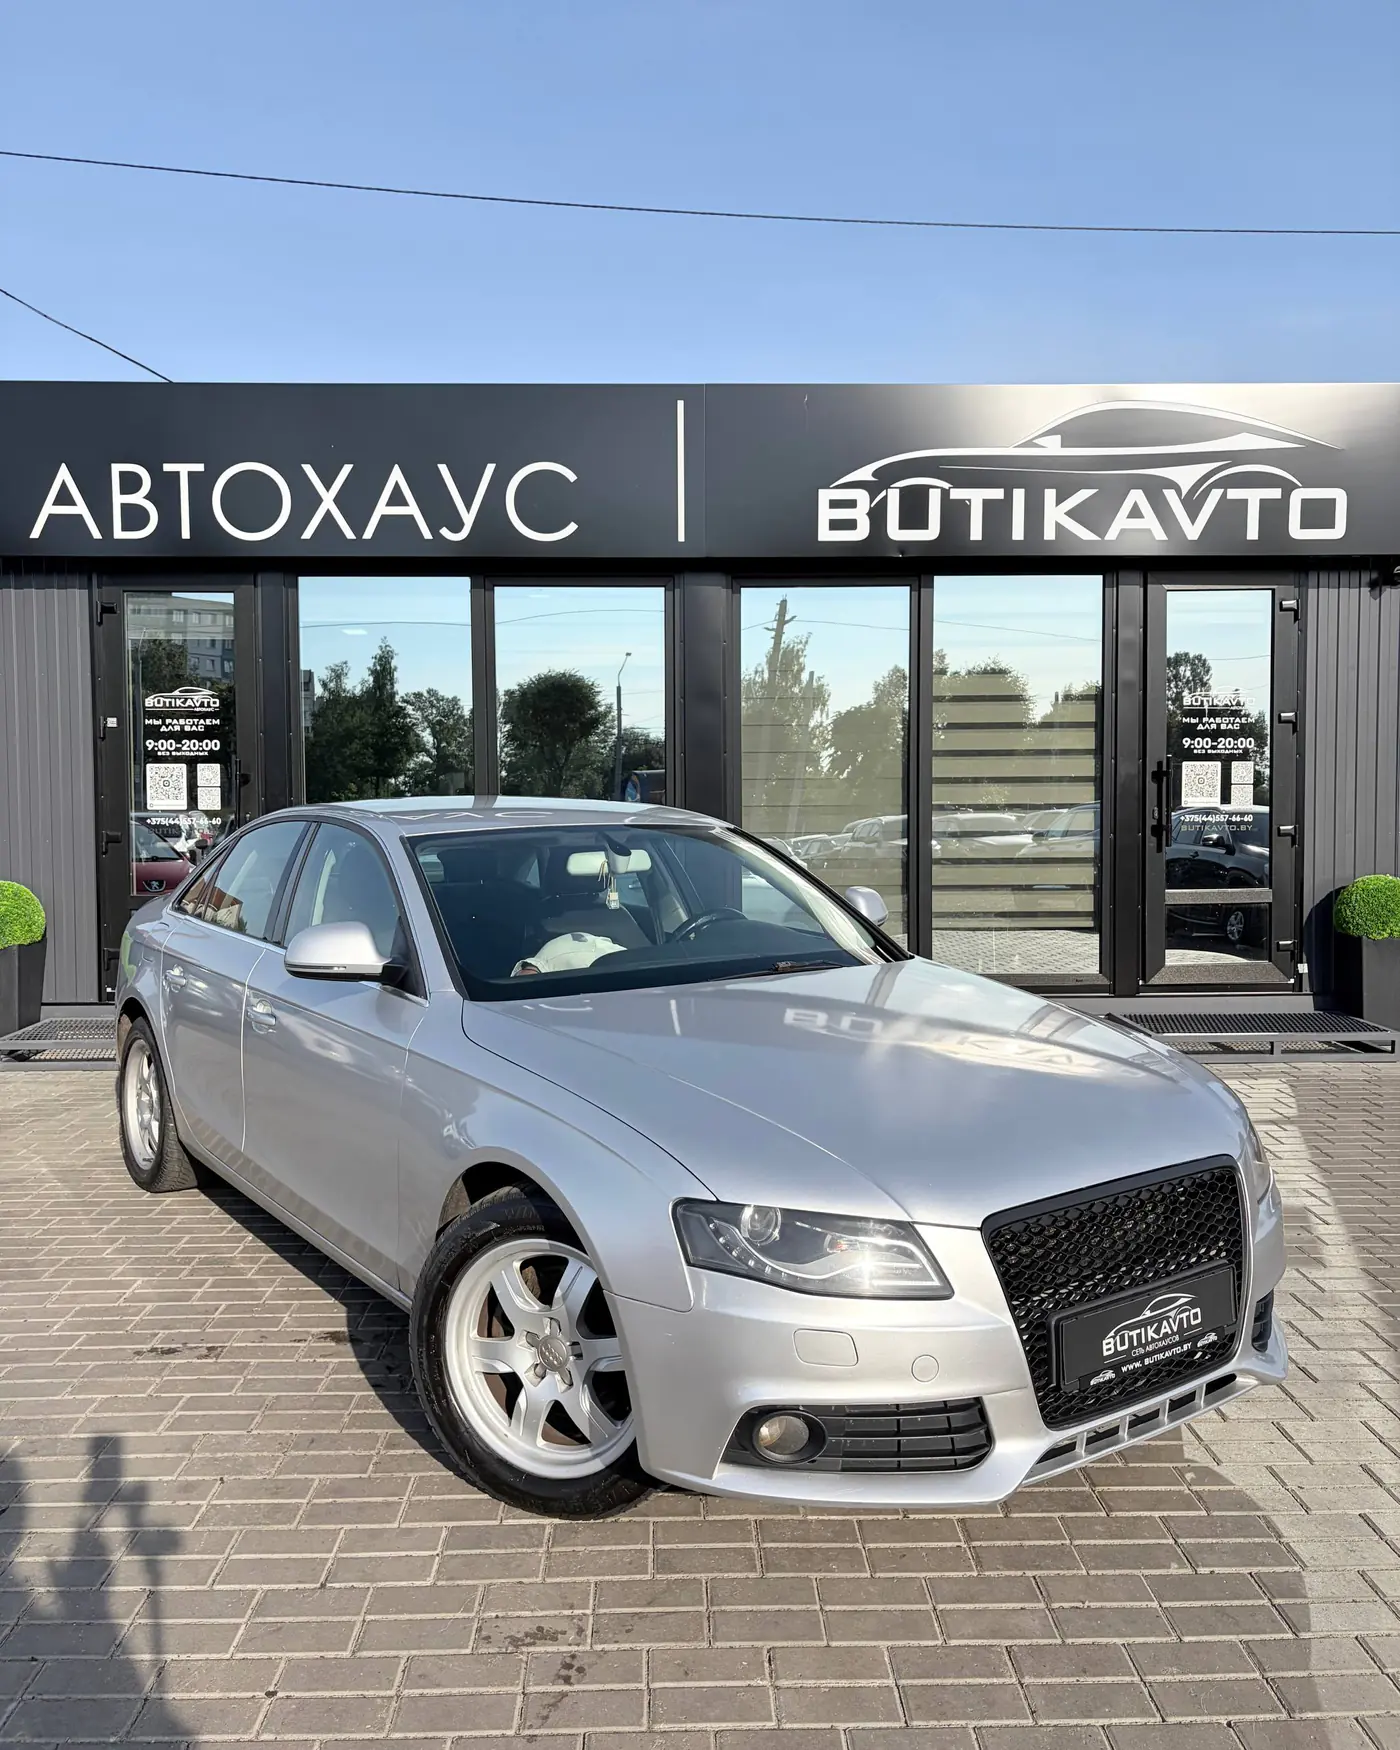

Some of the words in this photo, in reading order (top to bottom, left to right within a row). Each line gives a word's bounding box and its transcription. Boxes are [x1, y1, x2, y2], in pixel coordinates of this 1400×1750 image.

[29, 461, 578, 543] АВТОХАУС
[818, 487, 1347, 542] BUTIKAVTO
[144, 698, 220, 707] BUTIKAVTO
[1182, 697, 1256, 706] BUTIKAVTO
[145, 739, 221, 751] 9:00-20:00
[1182, 737, 1255, 749] 9:00-20:00
[1180, 814, 1254, 823] +375(44)557-66-60
[1102, 1307, 1202, 1356] BUTIKAVTO
[1131, 1348, 1145, 1357] СЕТЬ
[1145, 1335, 1180, 1353] АВТОХАУСОВ
[1120, 1361, 1142, 1373] WWW.
[1144, 1342, 1192, 1366] BUTIKAVTO.BY
